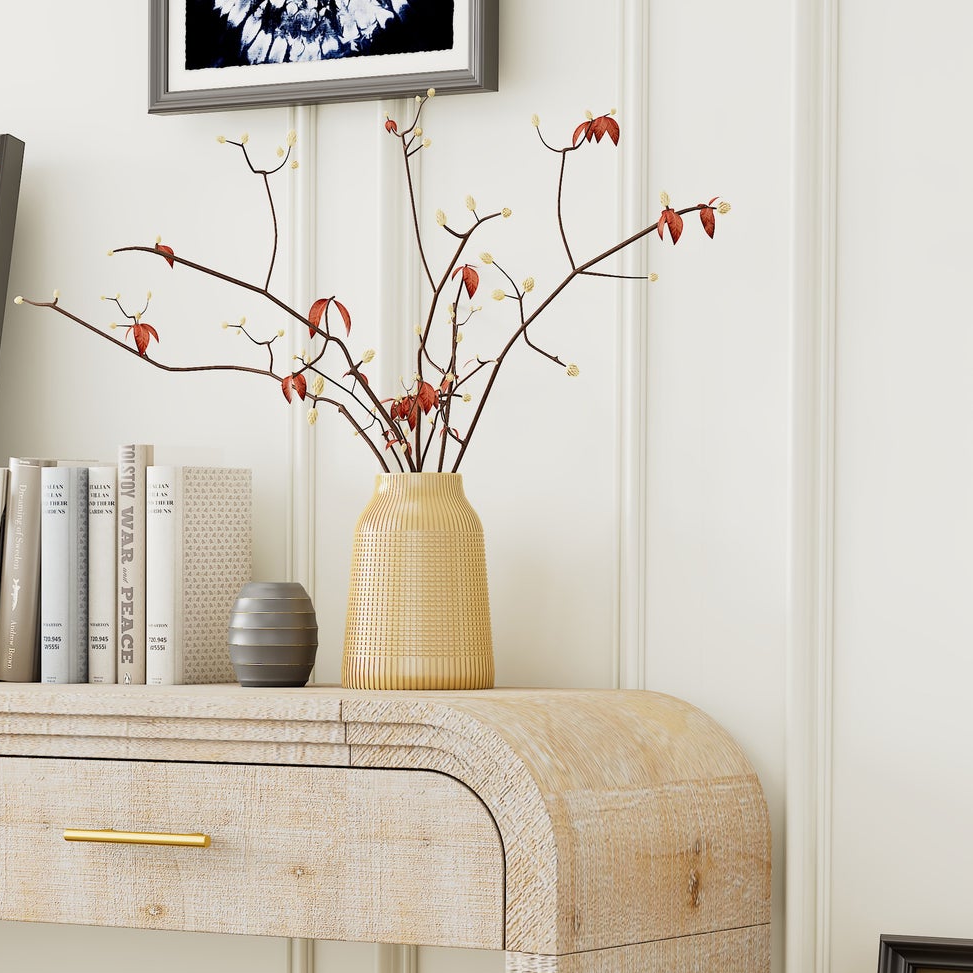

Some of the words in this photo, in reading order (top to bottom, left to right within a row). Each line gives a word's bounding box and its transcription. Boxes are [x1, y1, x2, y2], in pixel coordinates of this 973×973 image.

[15, 484, 27, 525] Dreaming
[16, 527, 24, 536] of
[121, 506, 134, 564] WAR
[13, 536, 24, 570] Sweden
[121, 586, 134, 664] PEACE
[7, 648, 16, 669] Brown
